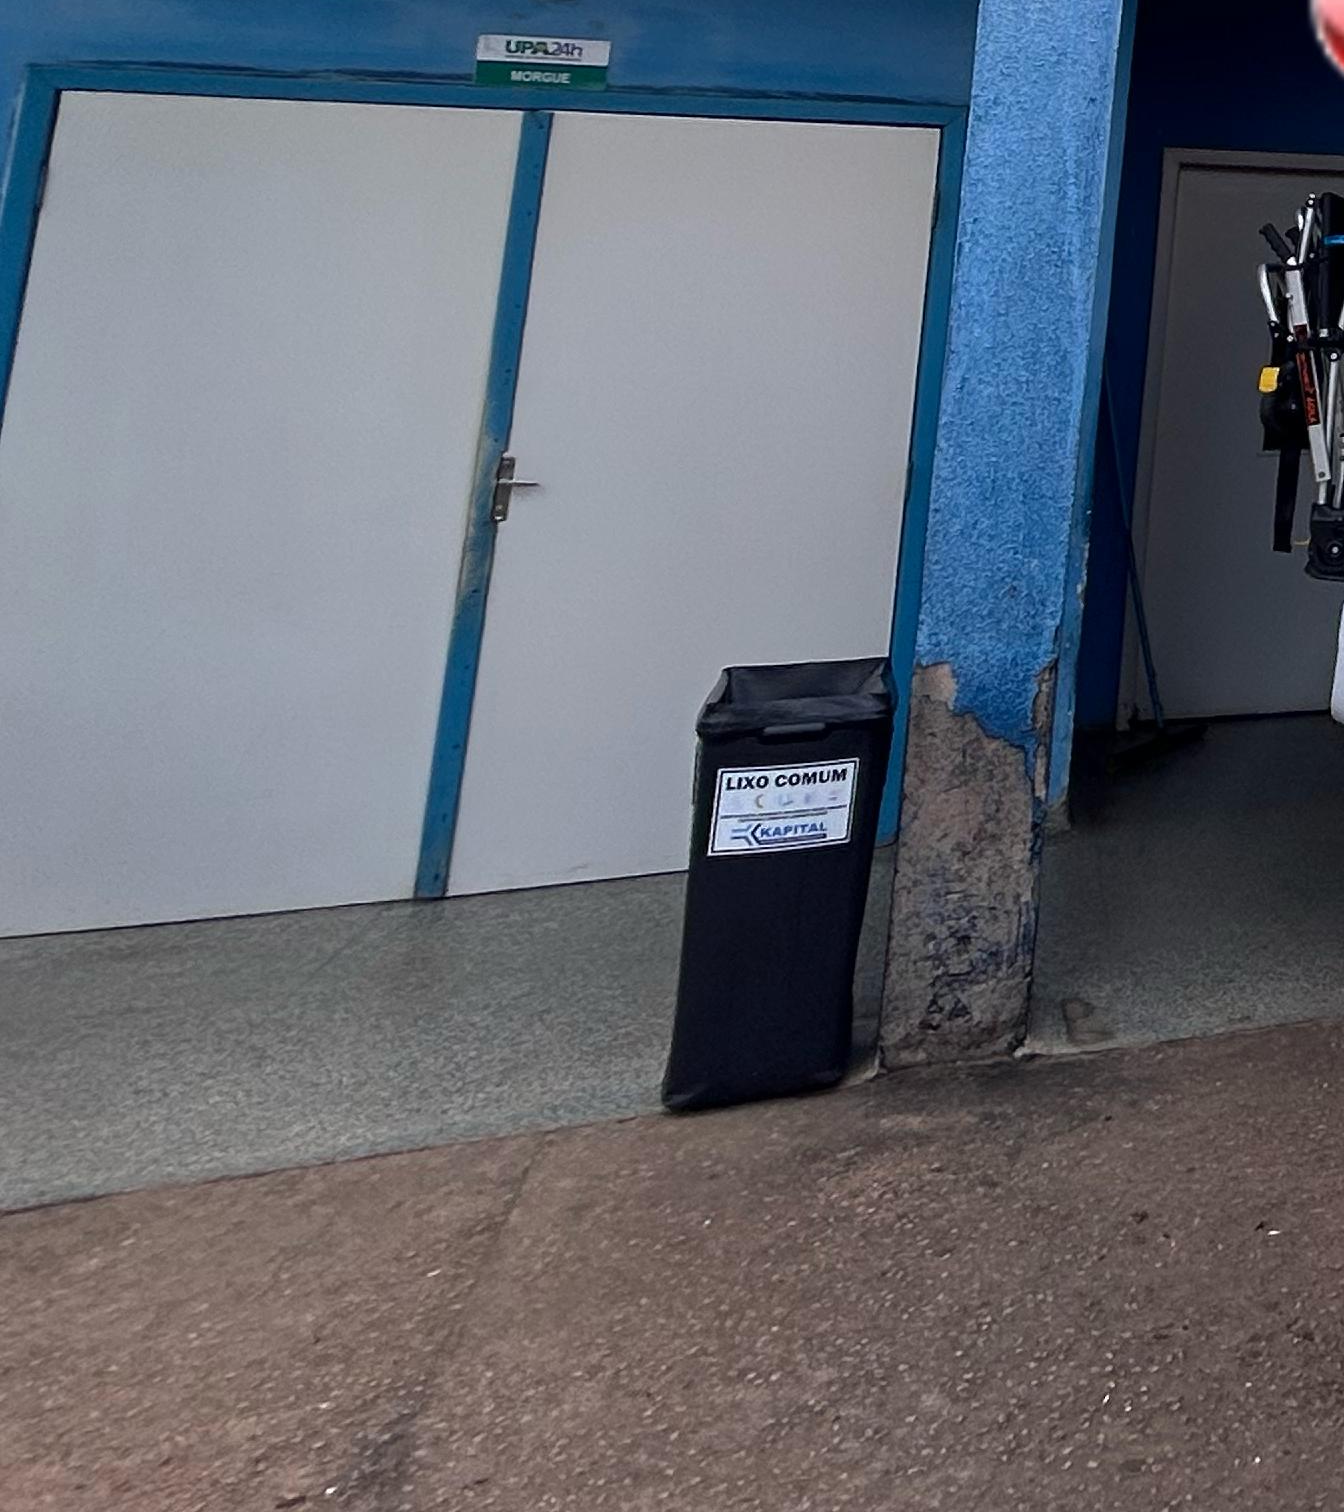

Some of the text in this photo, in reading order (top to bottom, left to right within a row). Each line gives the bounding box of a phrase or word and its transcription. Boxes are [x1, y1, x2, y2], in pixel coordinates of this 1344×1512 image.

[510, 71, 572, 84] MORGUE
[725, 768, 848, 791] LIXO COMUM
[759, 822, 828, 837] KAPITAL
